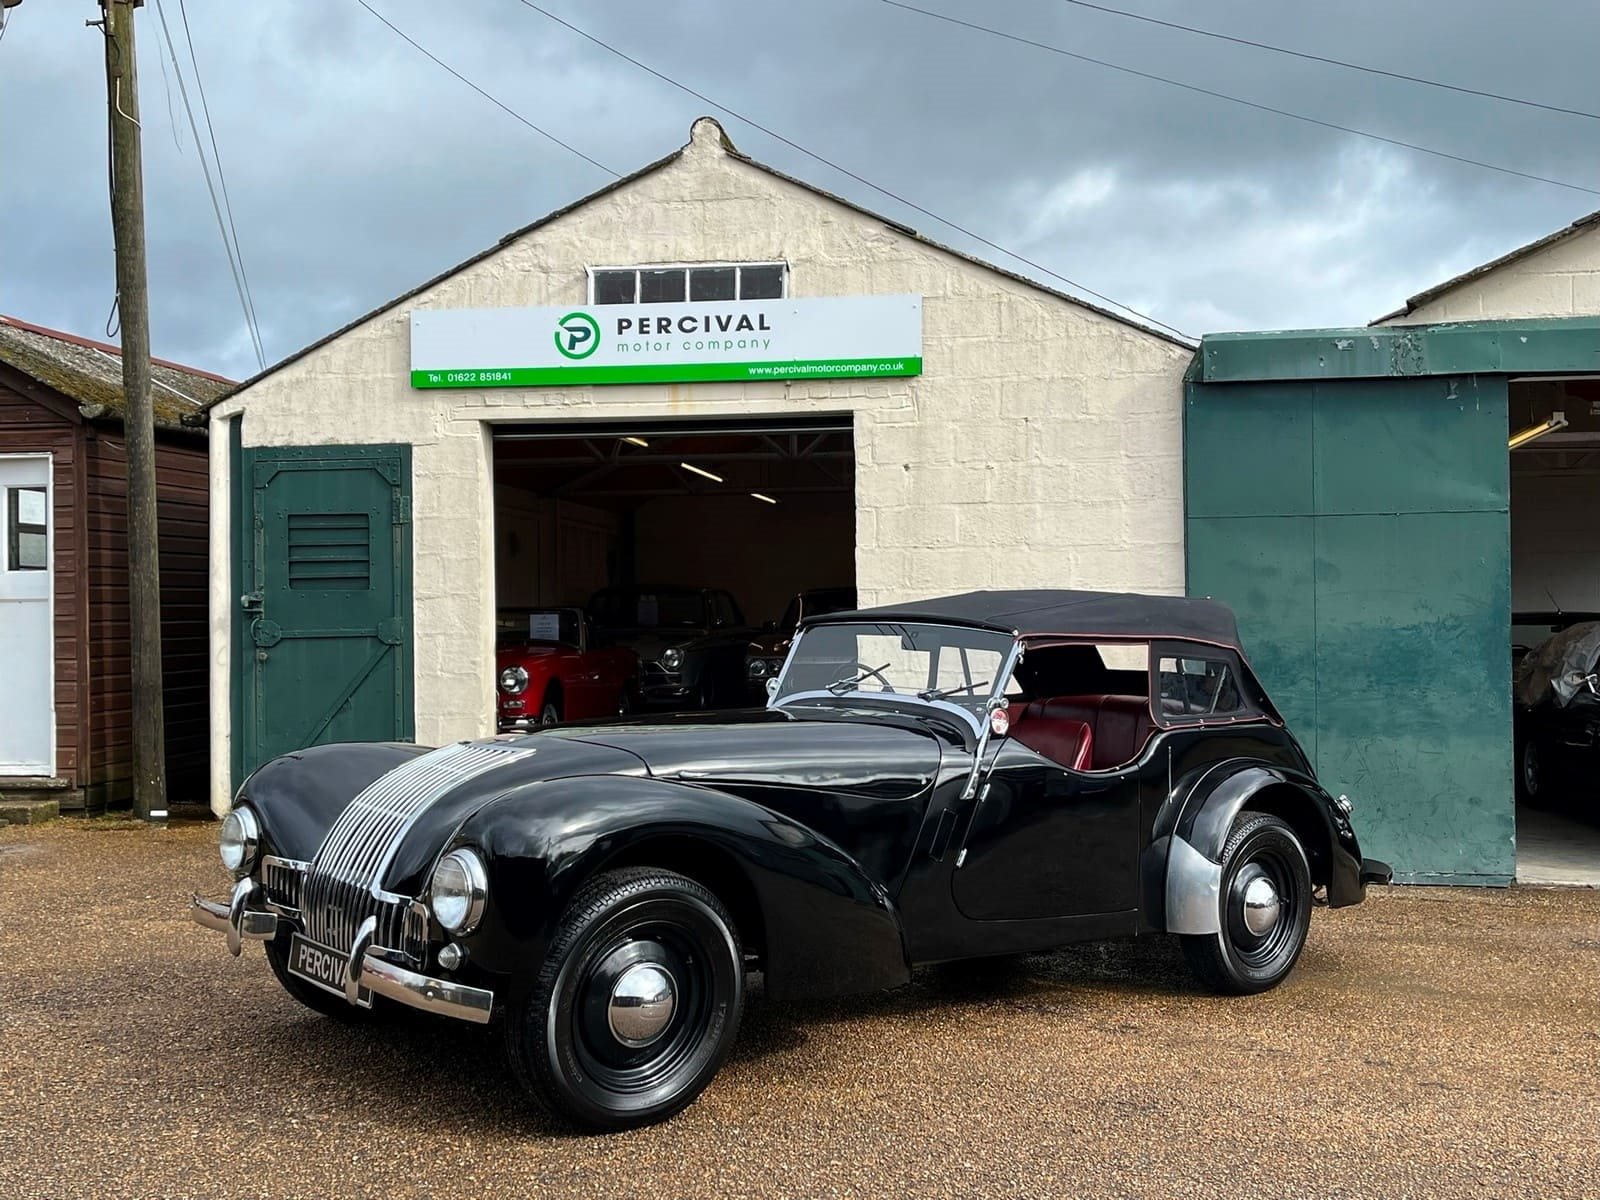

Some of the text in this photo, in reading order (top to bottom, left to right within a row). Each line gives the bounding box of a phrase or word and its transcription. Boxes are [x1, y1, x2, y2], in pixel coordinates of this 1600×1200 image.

[617, 313, 771, 335] PERCIVAL
[617, 338, 771, 352] motor company
[748, 361, 905, 376] www.percivalmotorcompany.co.uk
[428, 372, 512, 383] Tel. 01622 851841
[298, 944, 349, 987] PERCIVA
